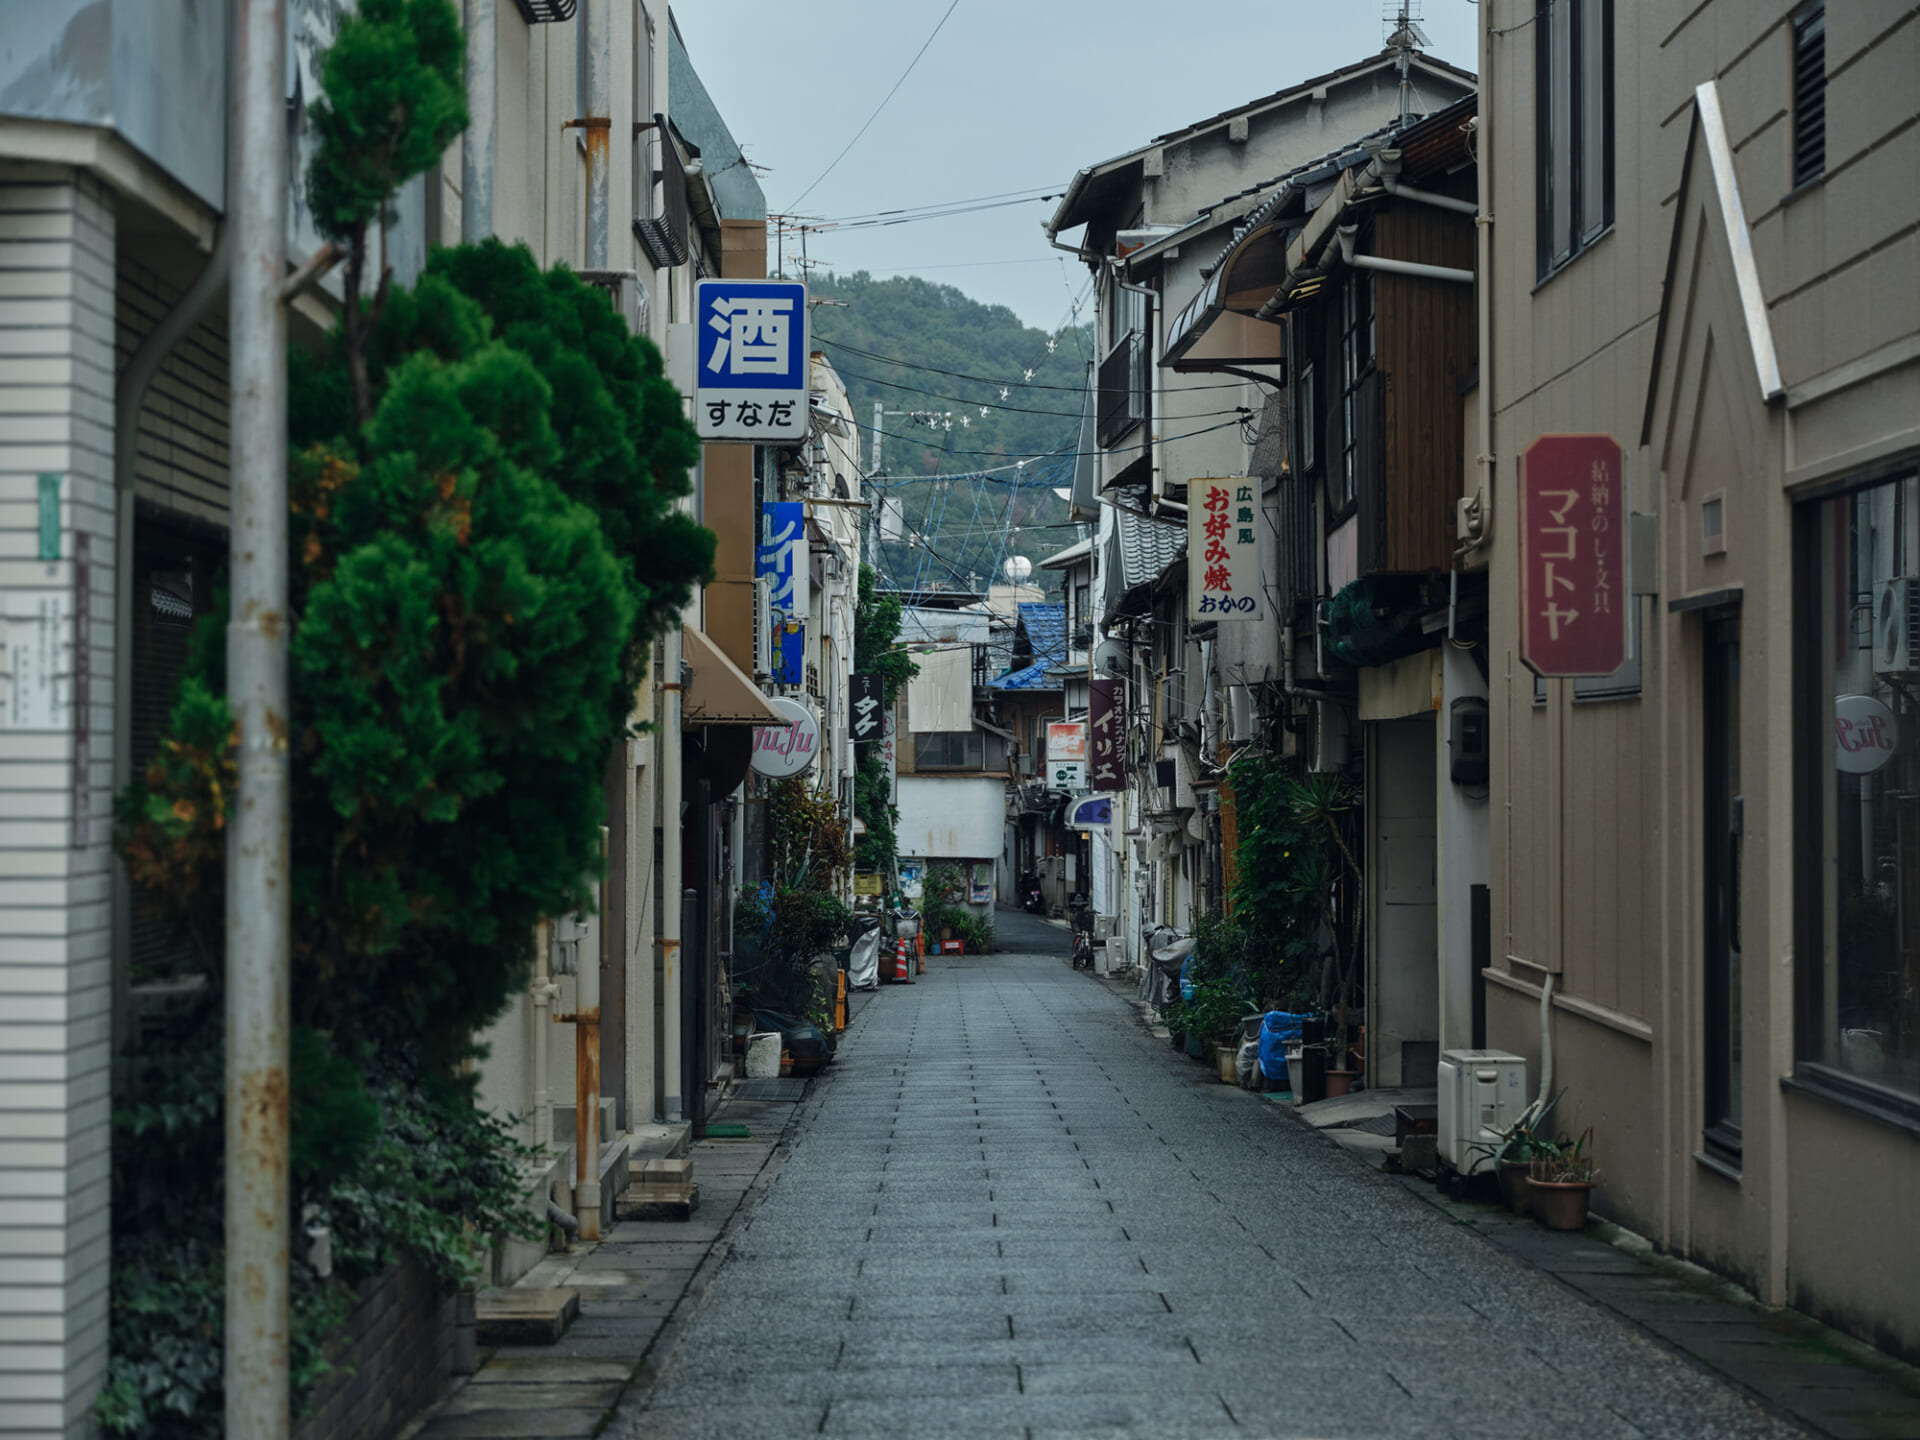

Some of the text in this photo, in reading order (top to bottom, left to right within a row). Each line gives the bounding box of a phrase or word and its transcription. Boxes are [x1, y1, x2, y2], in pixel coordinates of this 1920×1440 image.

[707, 297, 794, 375] 酒
[706, 400, 796, 427] すなだ
[1203, 486, 1232, 592] お好み焼
[1236, 486, 1255, 544] 広島風
[1538, 489, 1580, 641] マコトヤ
[1198, 594, 1256, 613] おかの
[1093, 709, 1116, 779] イリエ
[1113, 686, 1126, 762] カラオケスナック
